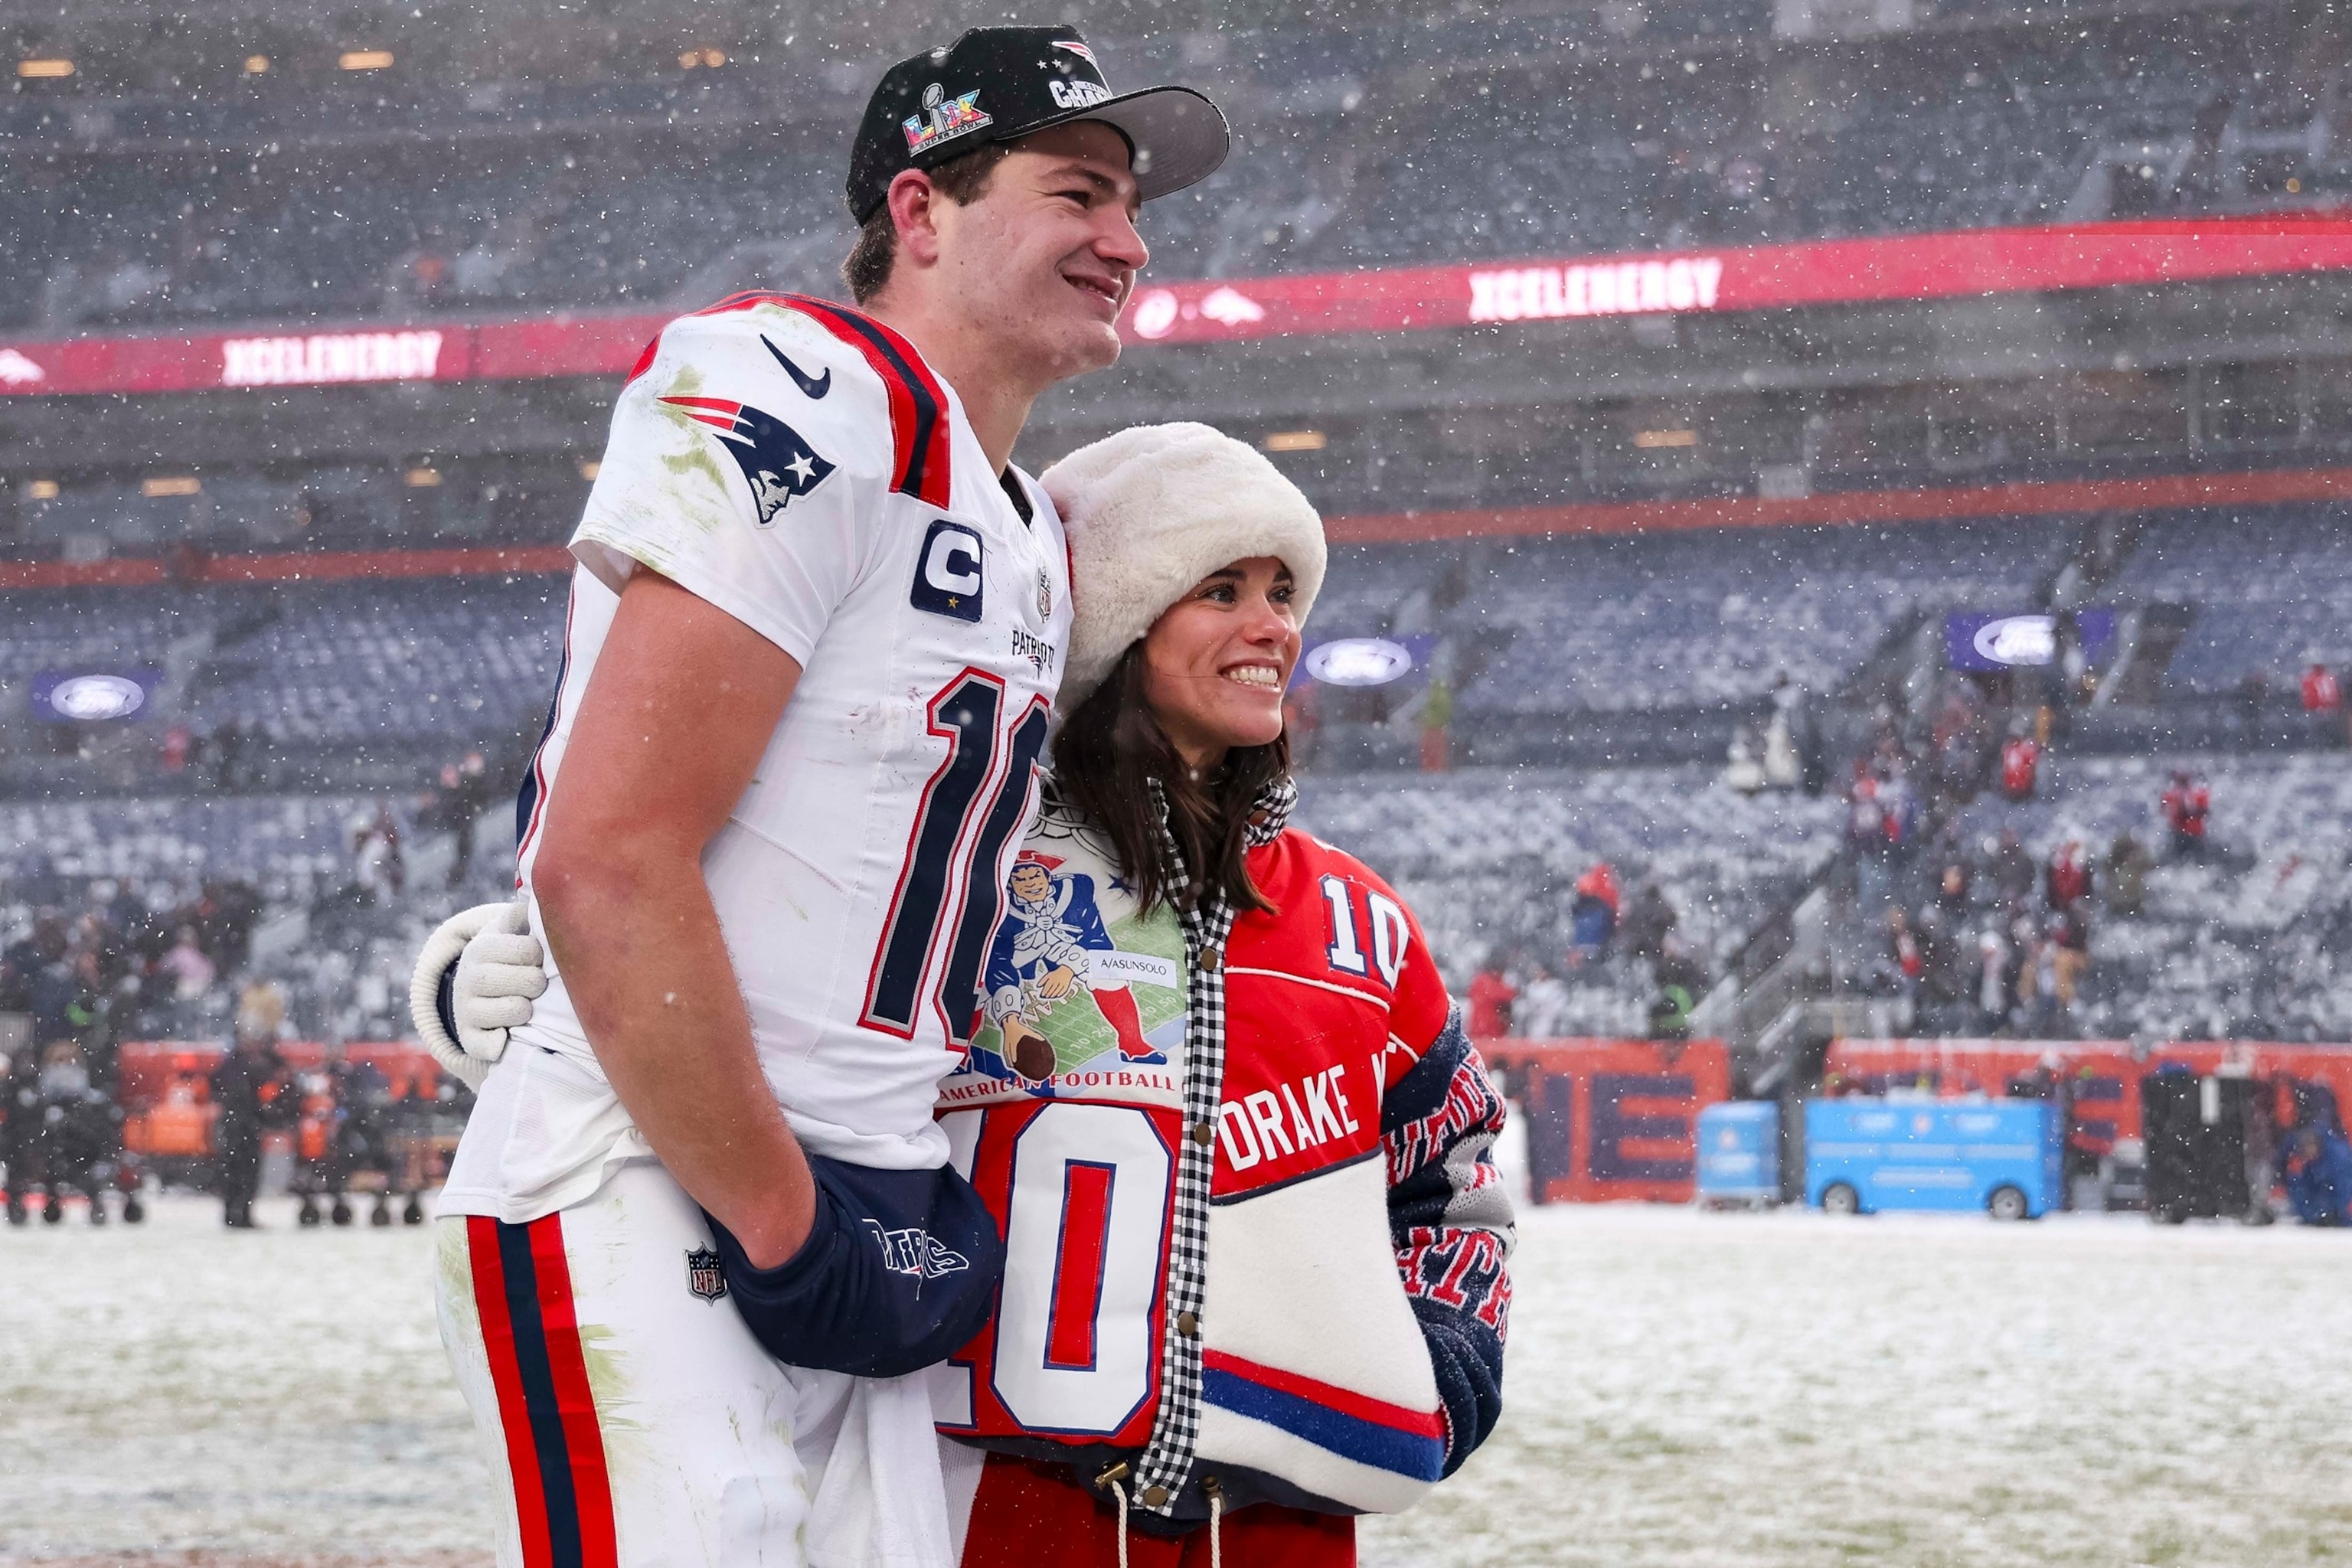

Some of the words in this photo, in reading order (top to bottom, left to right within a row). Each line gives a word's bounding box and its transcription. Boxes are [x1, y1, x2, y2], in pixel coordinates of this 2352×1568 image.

[925, 529, 981, 597] C
[1318, 873, 1410, 991] 10
[1100, 957, 1167, 976] A/ASUNSOLO
[939, 1074, 1040, 1102] AMERICAN
[1050, 1072, 1176, 1092] FOOTBALL
[1217, 1063, 1361, 1173] DRAKE
[692, 1269, 723, 1294] NFL
